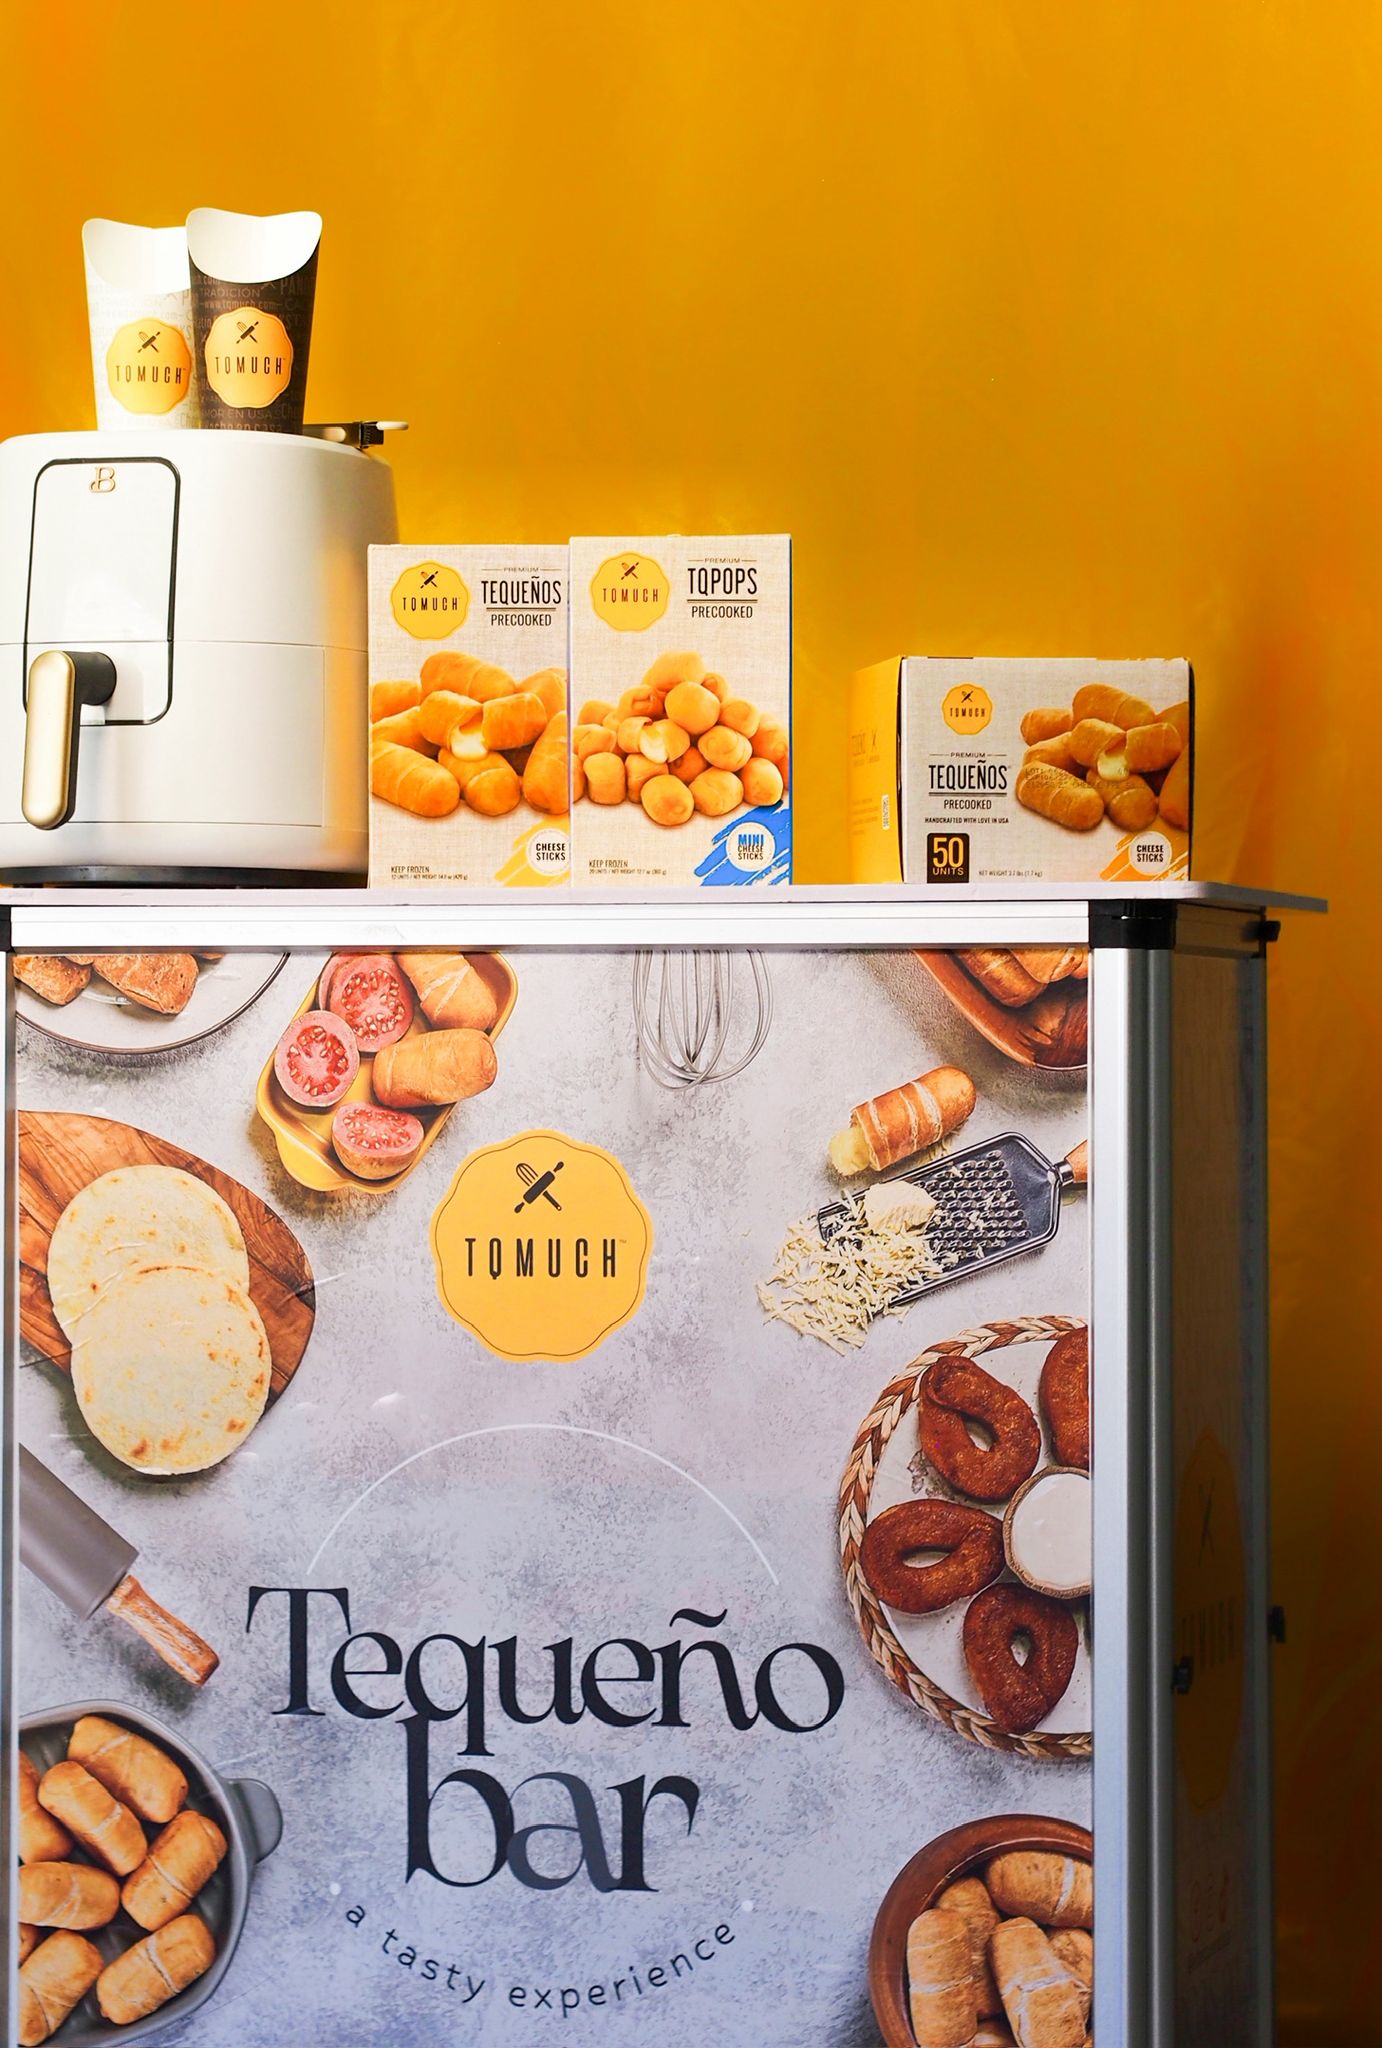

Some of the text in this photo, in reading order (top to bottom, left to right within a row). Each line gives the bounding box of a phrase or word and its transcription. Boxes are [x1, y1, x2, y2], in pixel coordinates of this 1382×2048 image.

[688, 568, 757, 596] TQPOPS
[481, 576, 561, 605] TEQUEÑOS
[691, 606, 753, 618] PRECOOKED
[491, 614, 552, 626] PRECOOKED
[928, 760, 1007, 790] TEQUEÑOS
[944, 799, 992, 809] PRECOOKED
[738, 834, 764, 845] MINI
[535, 843, 565, 851] CHEESE
[933, 837, 964, 868] 50
[535, 852, 566, 861] STICKS
[738, 852, 764, 860] STICKS
[1137, 853, 1164, 862] STICKS
[932, 867, 964, 876] UNITS
[246, 1585, 846, 1756] Tequeño
[396, 1712, 700, 1893] bar
[346, 1904, 736, 2017] a tasty experience
